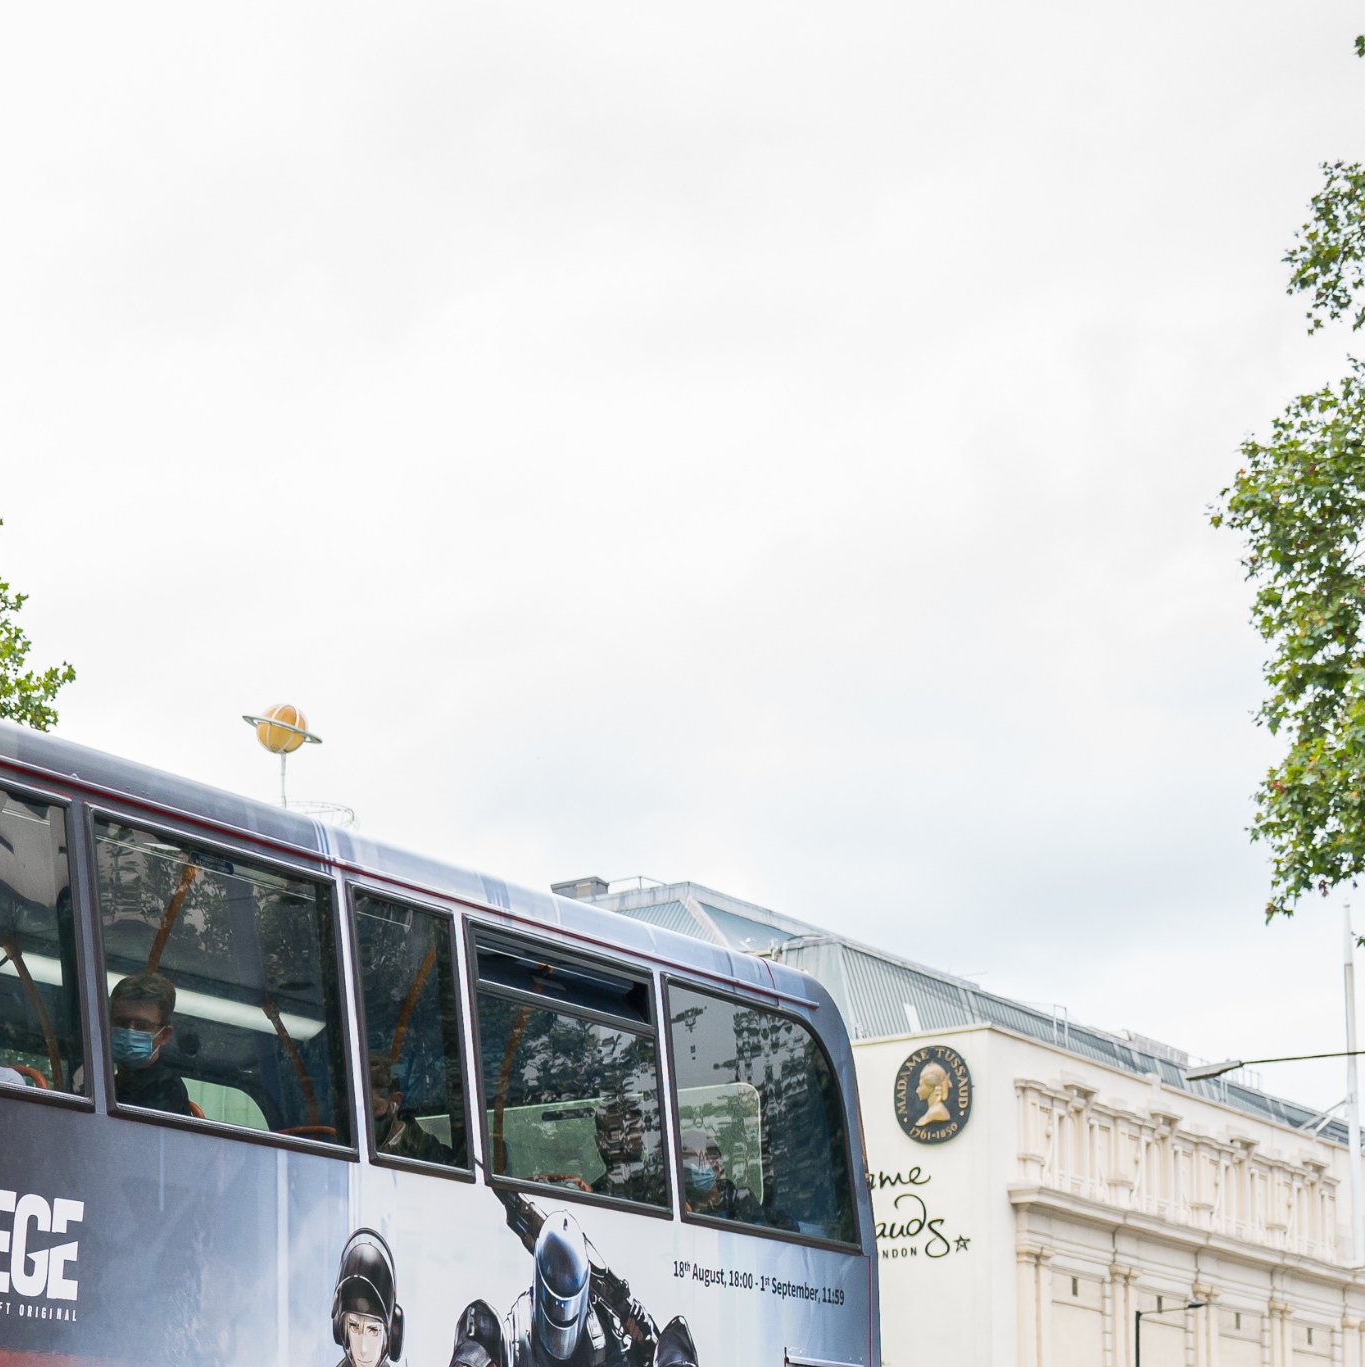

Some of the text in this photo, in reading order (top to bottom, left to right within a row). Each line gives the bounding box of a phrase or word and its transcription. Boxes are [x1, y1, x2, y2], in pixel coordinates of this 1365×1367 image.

[897, 1047, 969, 1115] MADAME TUSSAUD
[909, 1121, 958, 1141] 1761-1850
[875, 1193, 950, 1259] auds
[882, 1246, 917, 1260] NDON
[673, 1260, 691, 1278] 18th
[692, 1263, 727, 1288] August,
[729, 1270, 753, 1290] 18:00
[760, 1275, 770, 1292] 1st
[771, 1277, 821, 1305] September,
[822, 1287, 845, 1306] 11:59
[19, 1304, 77, 1322] ORIGINAL
